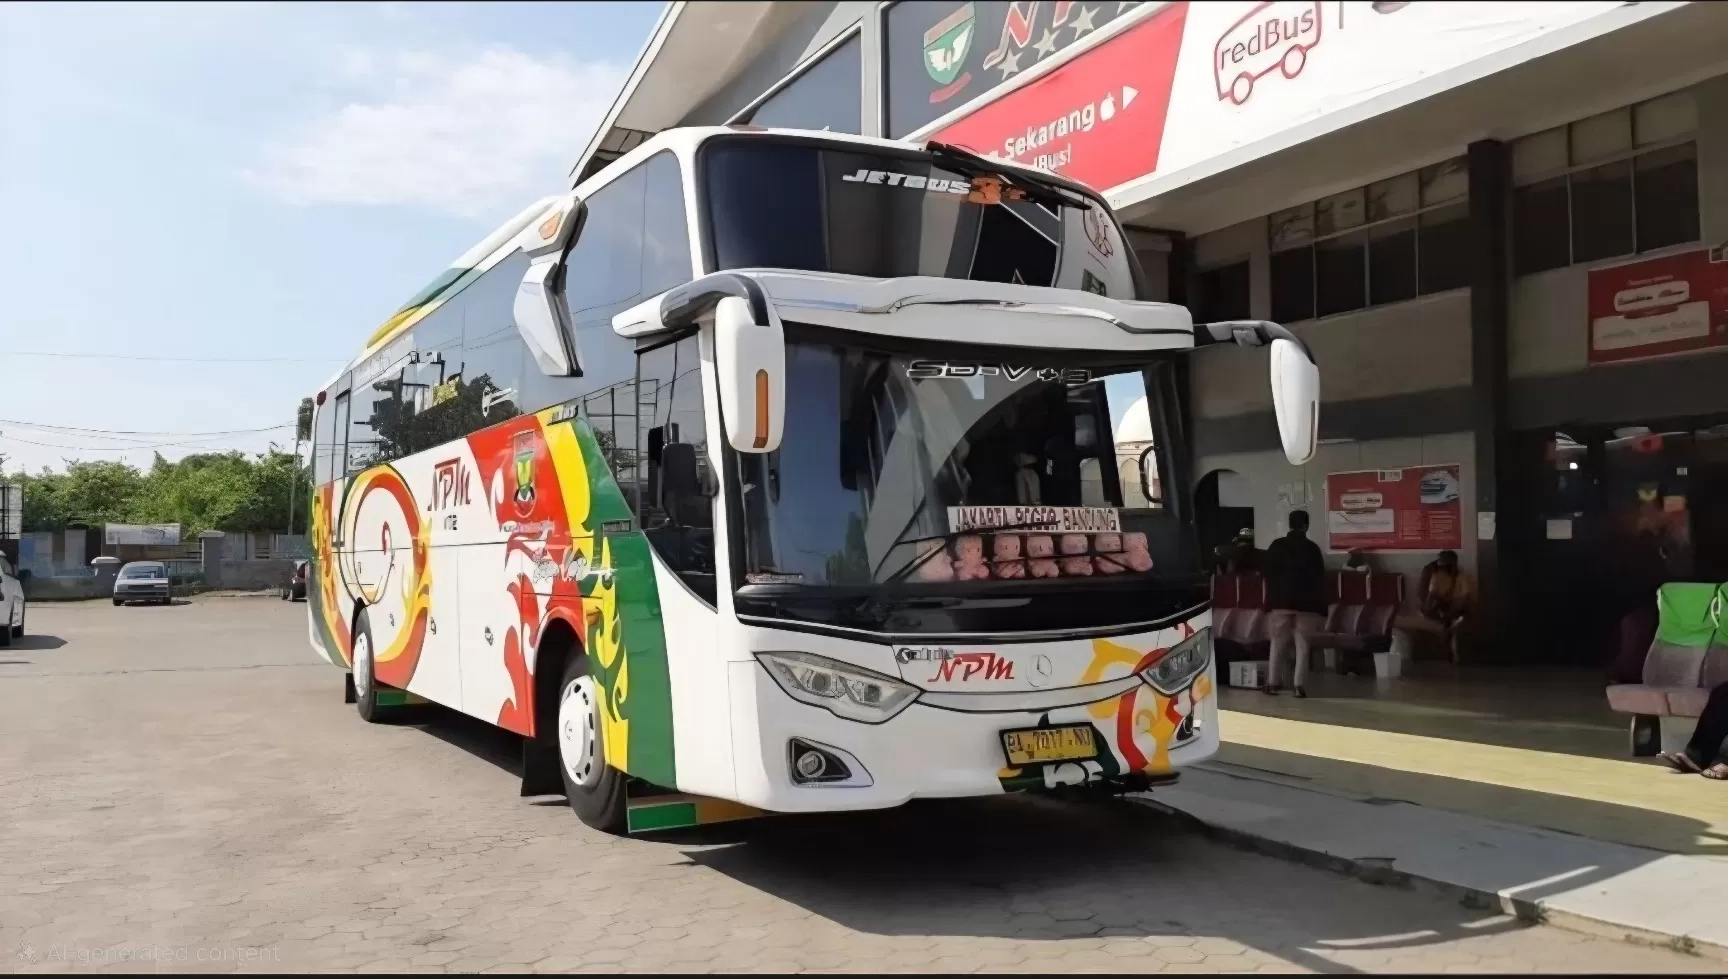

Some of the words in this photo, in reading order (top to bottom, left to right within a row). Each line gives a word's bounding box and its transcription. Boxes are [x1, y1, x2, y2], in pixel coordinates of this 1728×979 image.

[1220, 8, 1314, 70] redBus
[1004, 102, 1095, 160] Sekarang
[427, 456, 472, 511] NPM
[927, 652, 1015, 683] NPM
